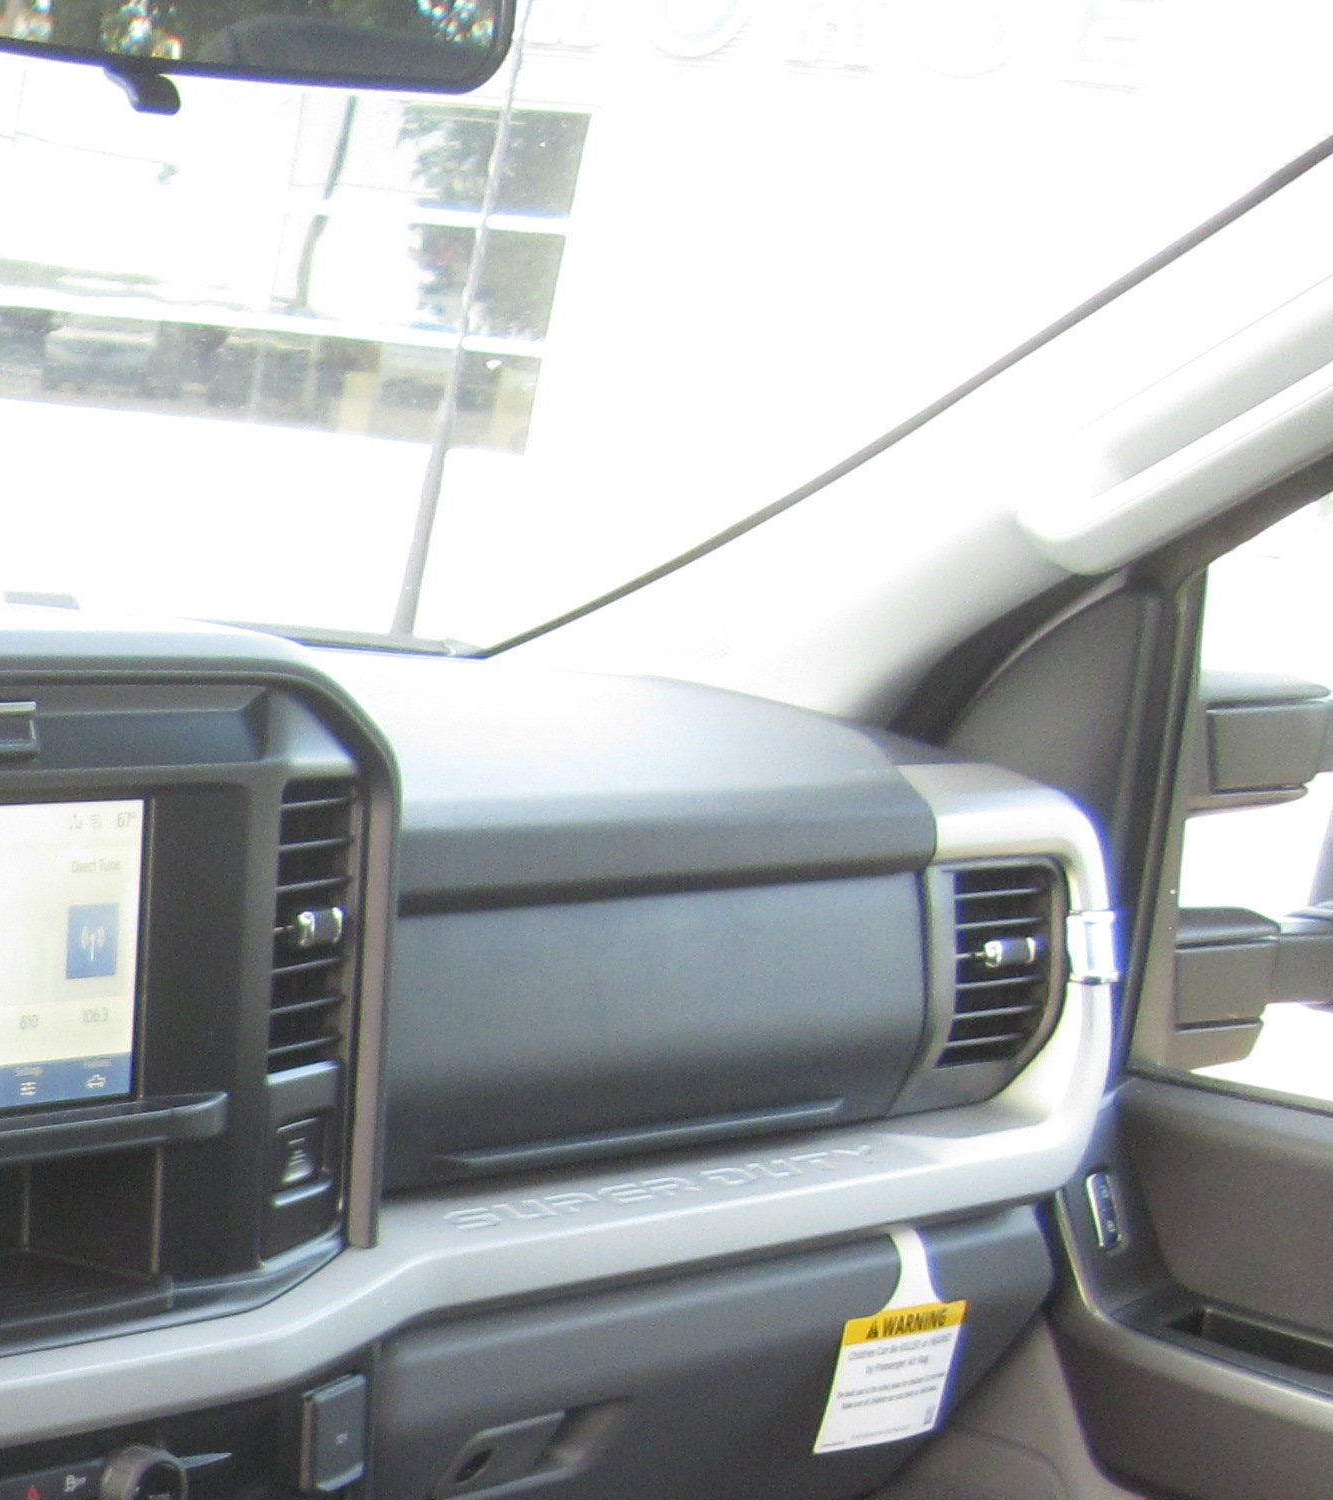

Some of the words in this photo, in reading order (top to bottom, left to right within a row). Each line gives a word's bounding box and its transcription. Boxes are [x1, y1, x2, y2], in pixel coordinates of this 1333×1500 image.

[445, 1176, 701, 1231] SUPER
[702, 1143, 872, 1188] DUTY
[882, 1308, 948, 1338] WARNING
